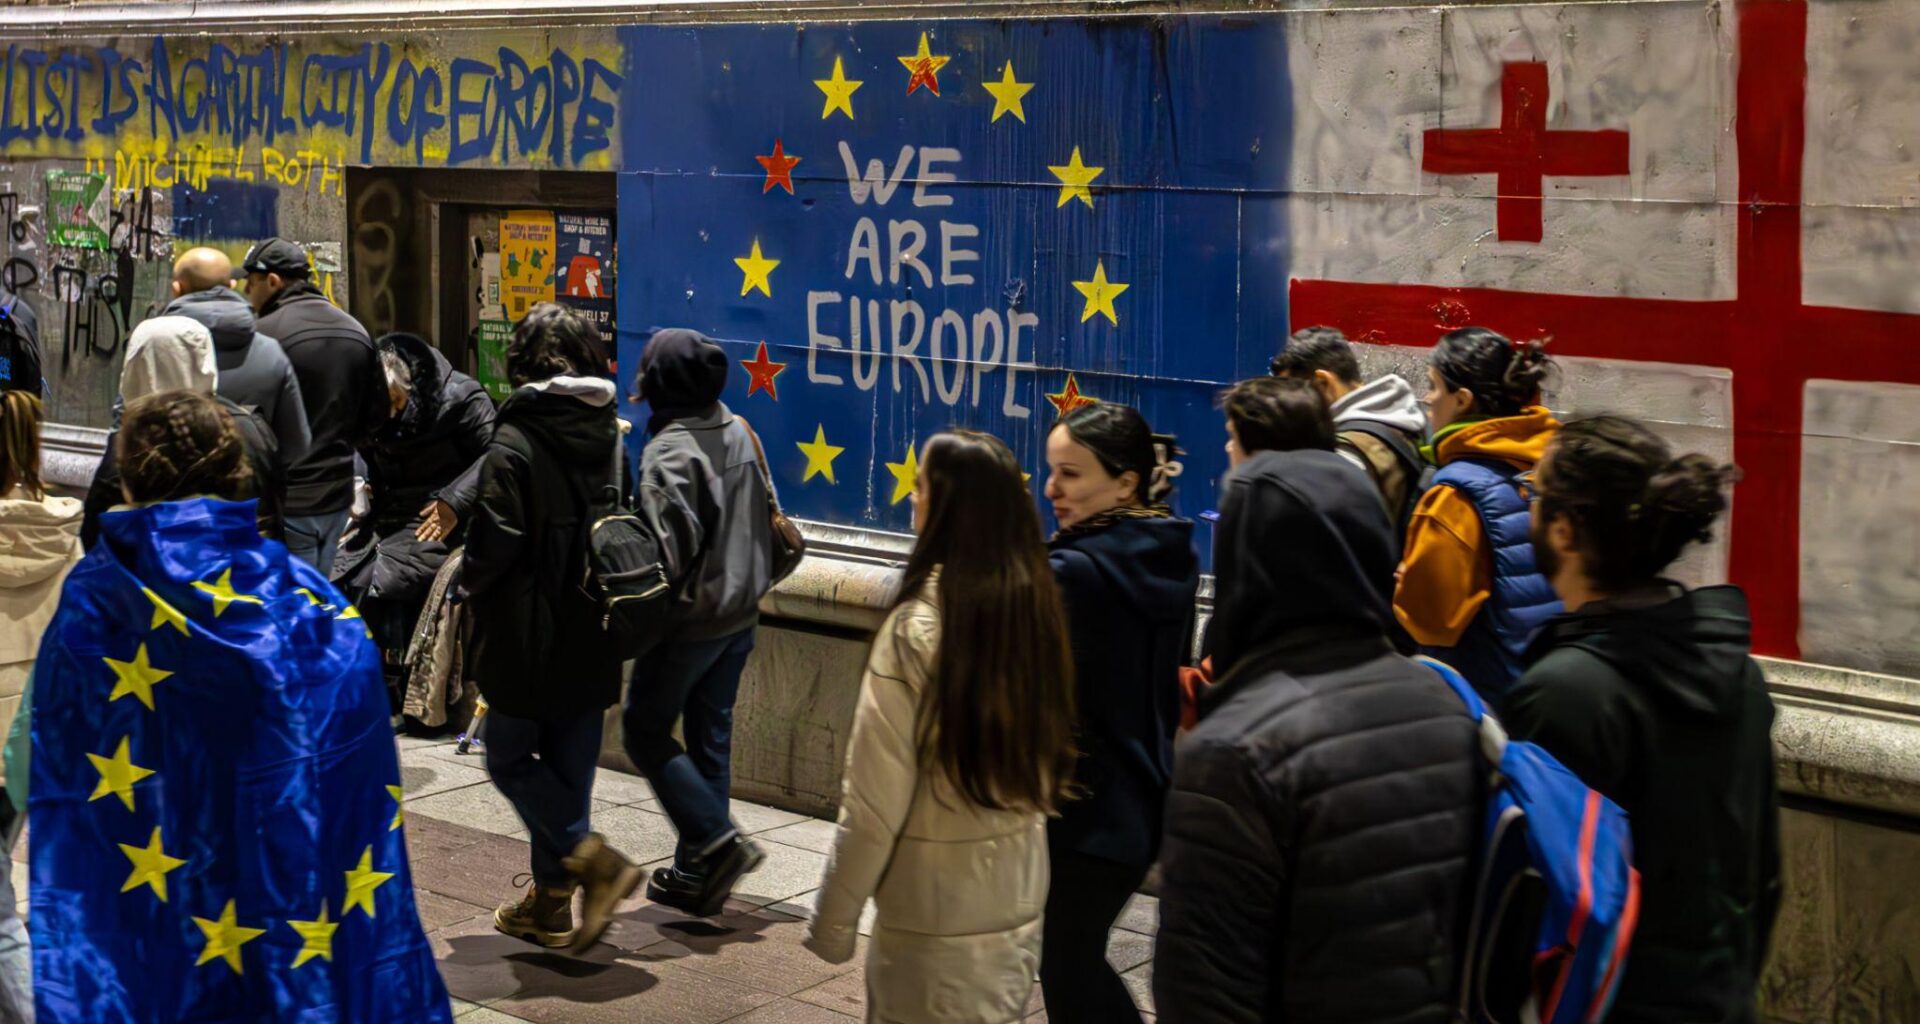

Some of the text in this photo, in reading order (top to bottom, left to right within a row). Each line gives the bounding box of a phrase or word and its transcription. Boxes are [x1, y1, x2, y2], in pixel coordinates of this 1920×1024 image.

[301, 42, 390, 165] CITY
[387, 58, 445, 165] OF
[448, 46, 624, 167] EUROPE
[261, 146, 343, 197] ROTH
[838, 140, 962, 207] WE
[844, 216, 980, 288] ARE
[807, 291, 1039, 418] EUROPE
